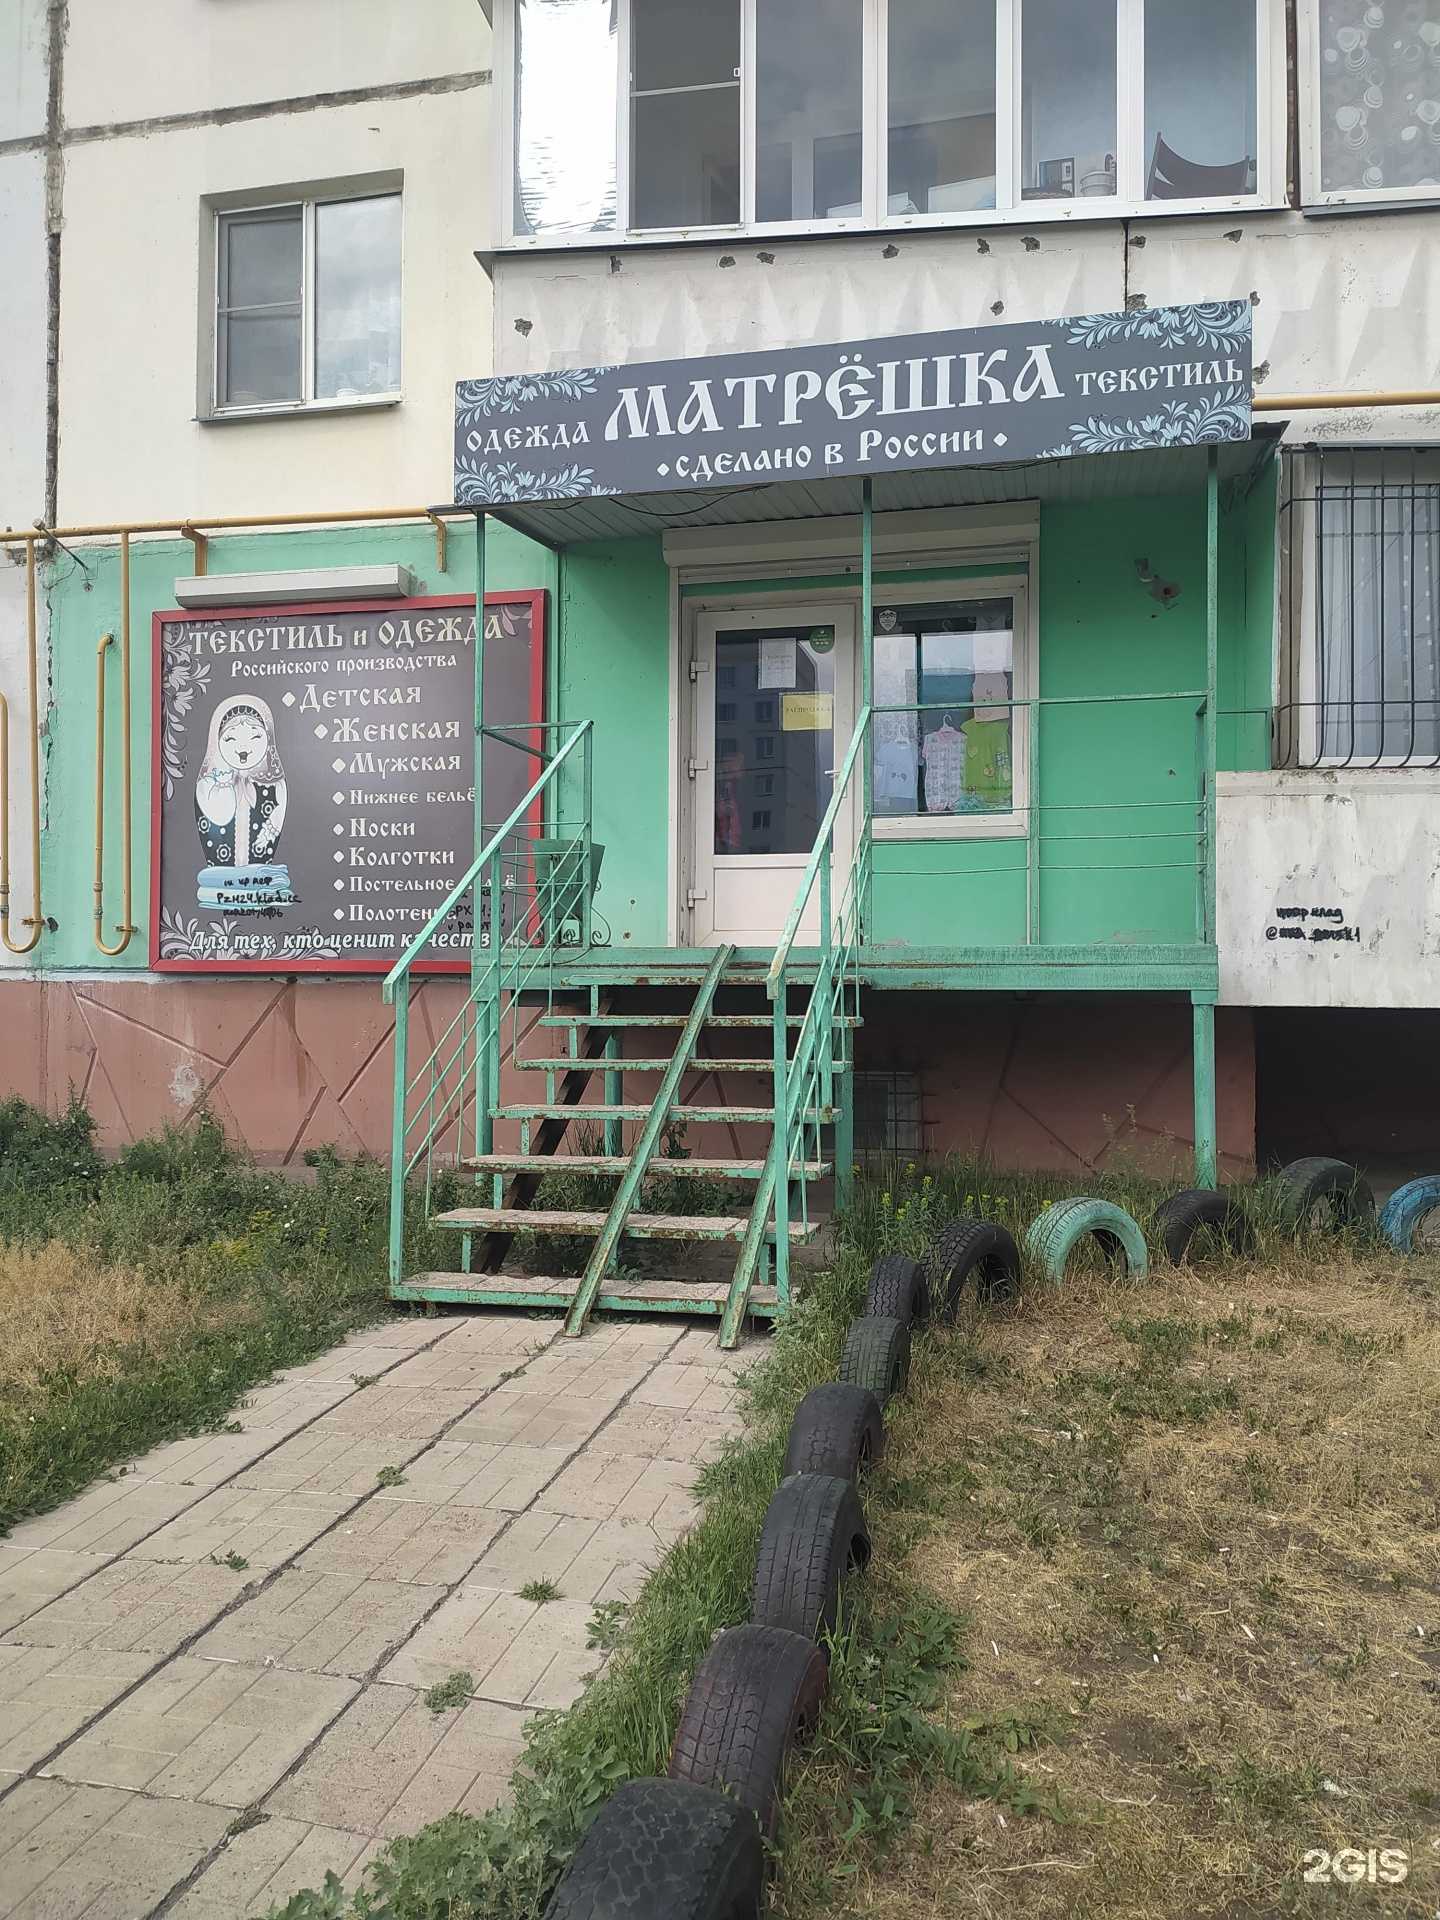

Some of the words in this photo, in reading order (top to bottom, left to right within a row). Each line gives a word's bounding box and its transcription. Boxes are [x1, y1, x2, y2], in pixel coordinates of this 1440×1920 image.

[1074, 358, 1244, 397] ТЕКСТИЛЬ
[604, 343, 1066, 441] МАТРЁШКА
[465, 421, 591, 455] ОДЕЖДА
[675, 445, 812, 483] сделано
[824, 443, 844, 465] в
[857, 429, 984, 462] России
[188, 624, 343, 655] ТЕКСТИЛЬ
[231, 659, 329, 678] Российского
[336, 654, 458, 677] производства
[299, 683, 422, 713] Детская
[331, 717, 461, 743] Женская
[349, 752, 462, 780] Мужская
[350, 789, 419, 806] Нижнее
[349, 817, 416, 838] Носки
[349, 846, 455, 867] Колготки
[349, 876, 456, 893] Постельное
[190, 930, 229, 951] Для
[283, 933, 321, 948] кто
[330, 932, 396, 951] ценит
